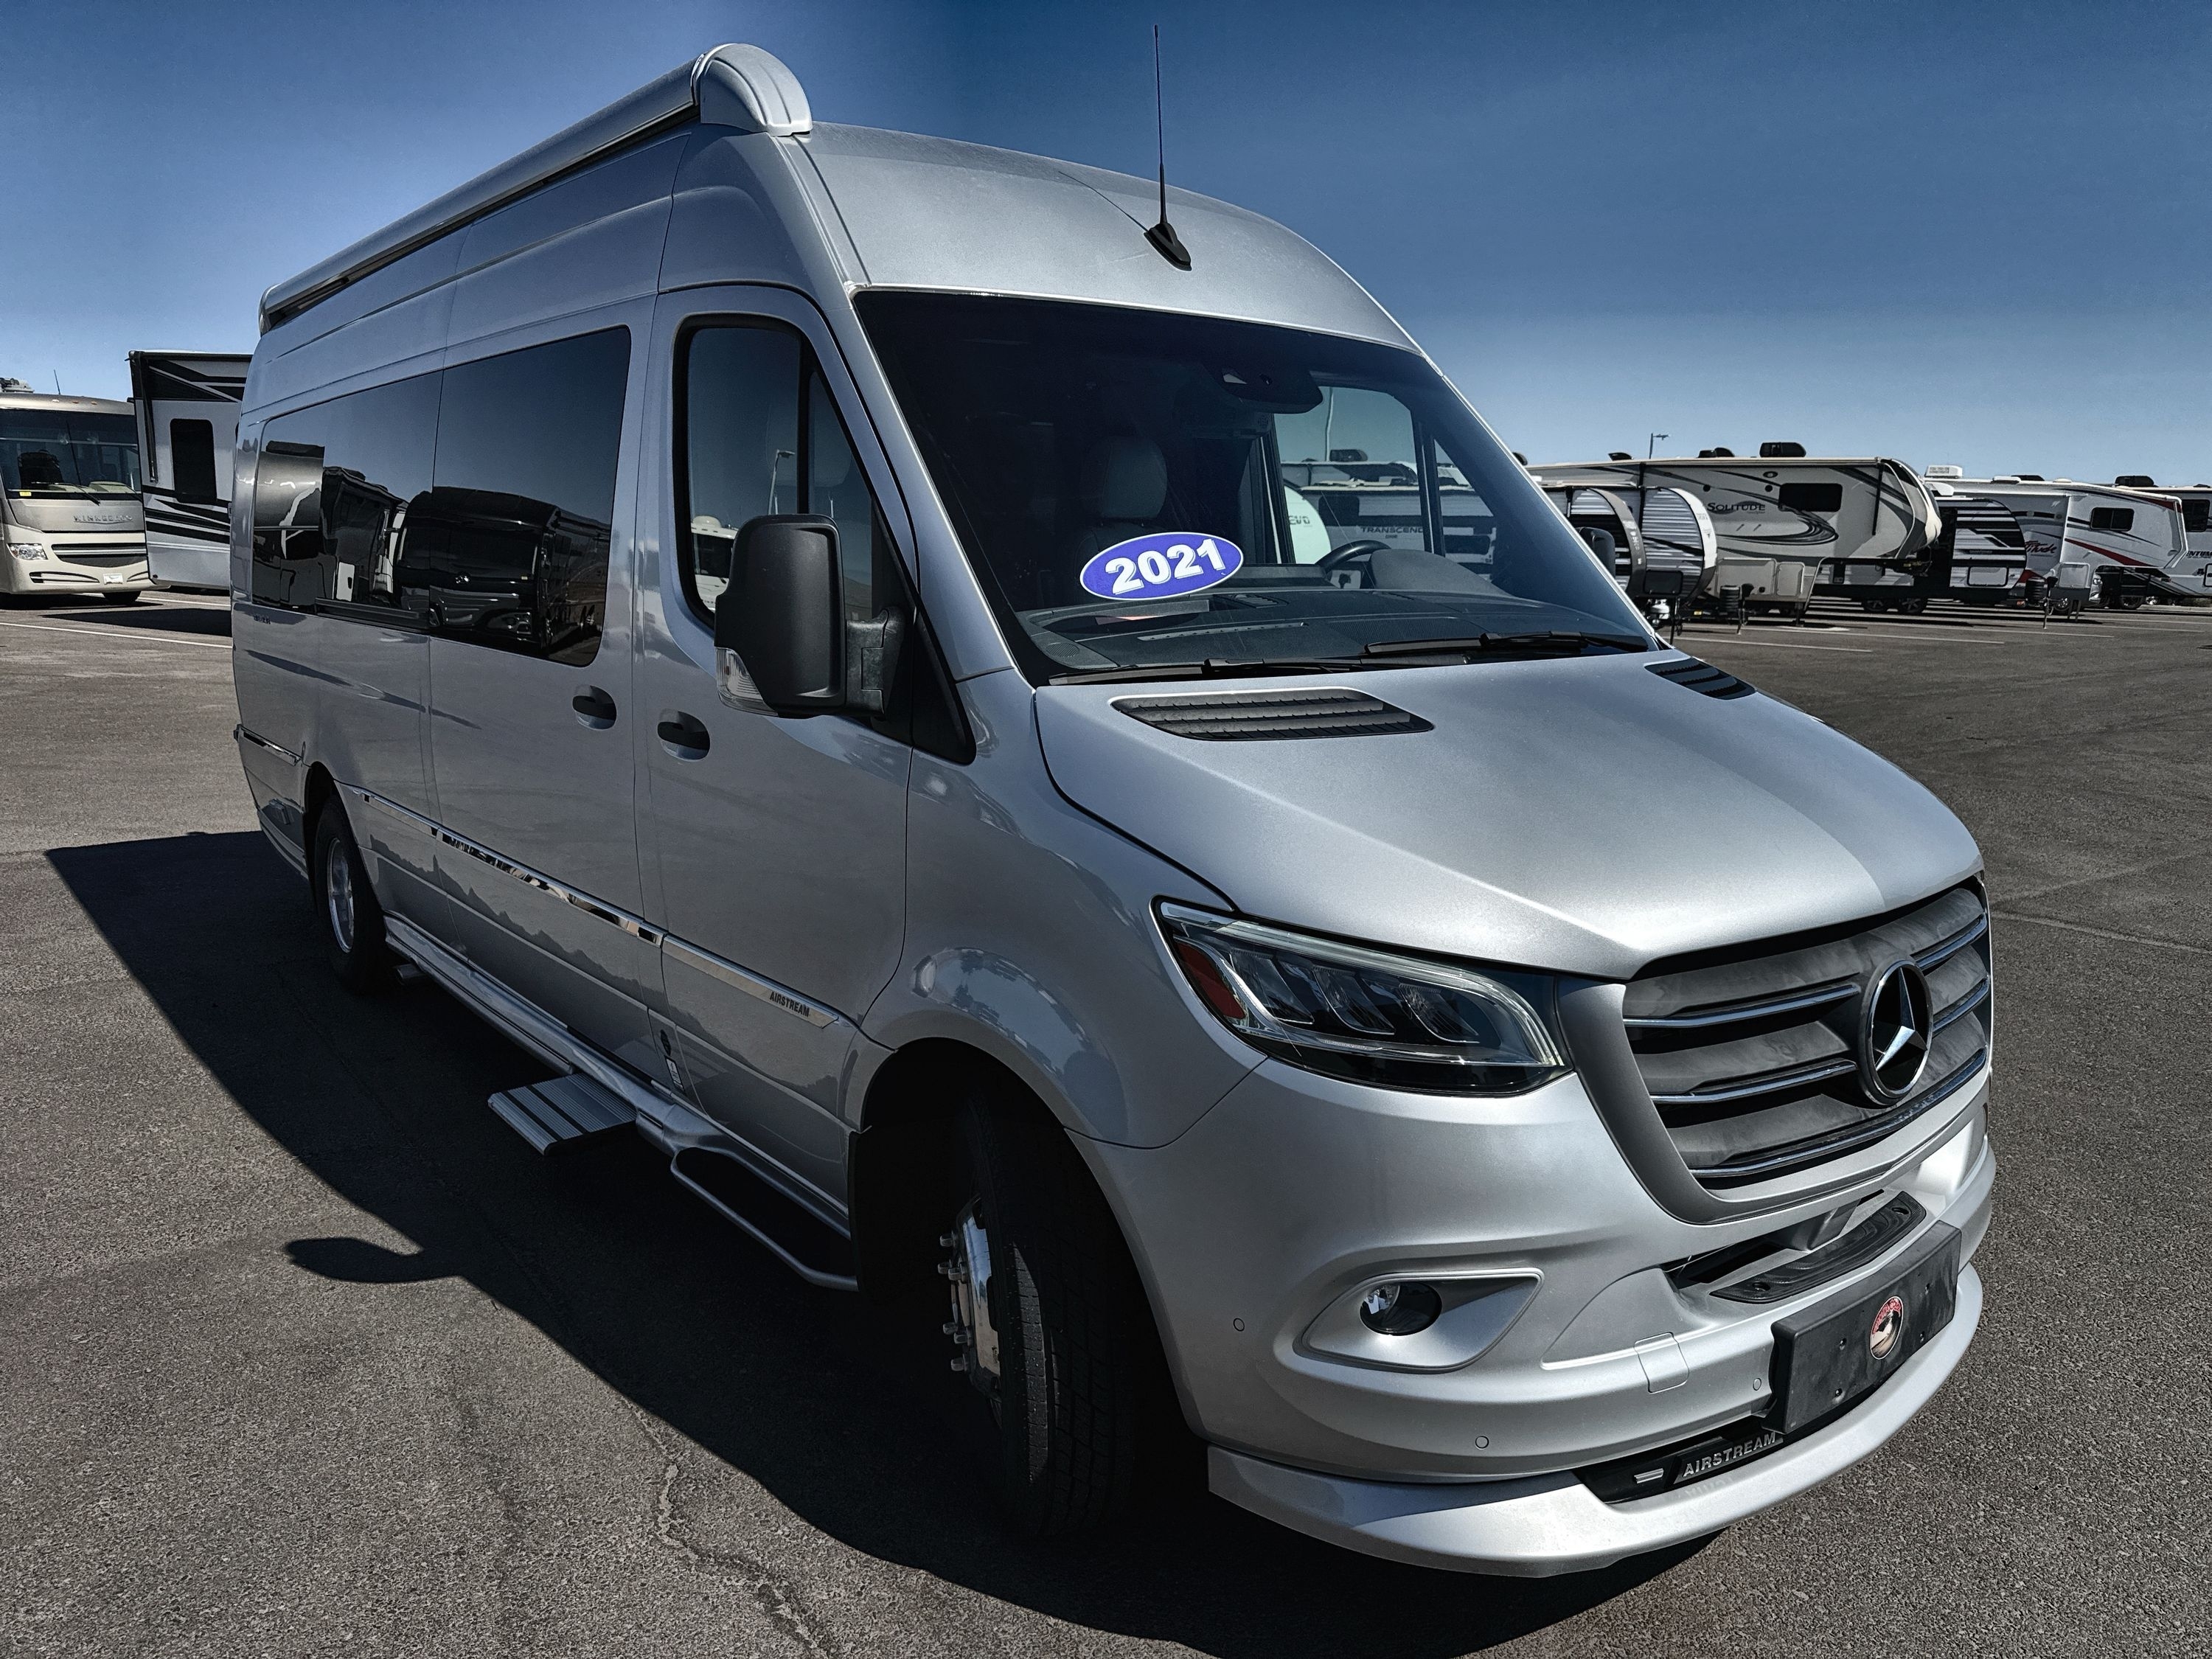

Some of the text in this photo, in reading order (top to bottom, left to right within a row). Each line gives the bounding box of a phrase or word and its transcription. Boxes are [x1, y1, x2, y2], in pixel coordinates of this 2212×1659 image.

[1707, 503, 1765, 512] SOLITUDE
[1105, 538, 1225, 595] 2021
[769, 991, 810, 1018] AIRSTREAM
[1683, 1432, 1776, 1477] AIRSTREAM
